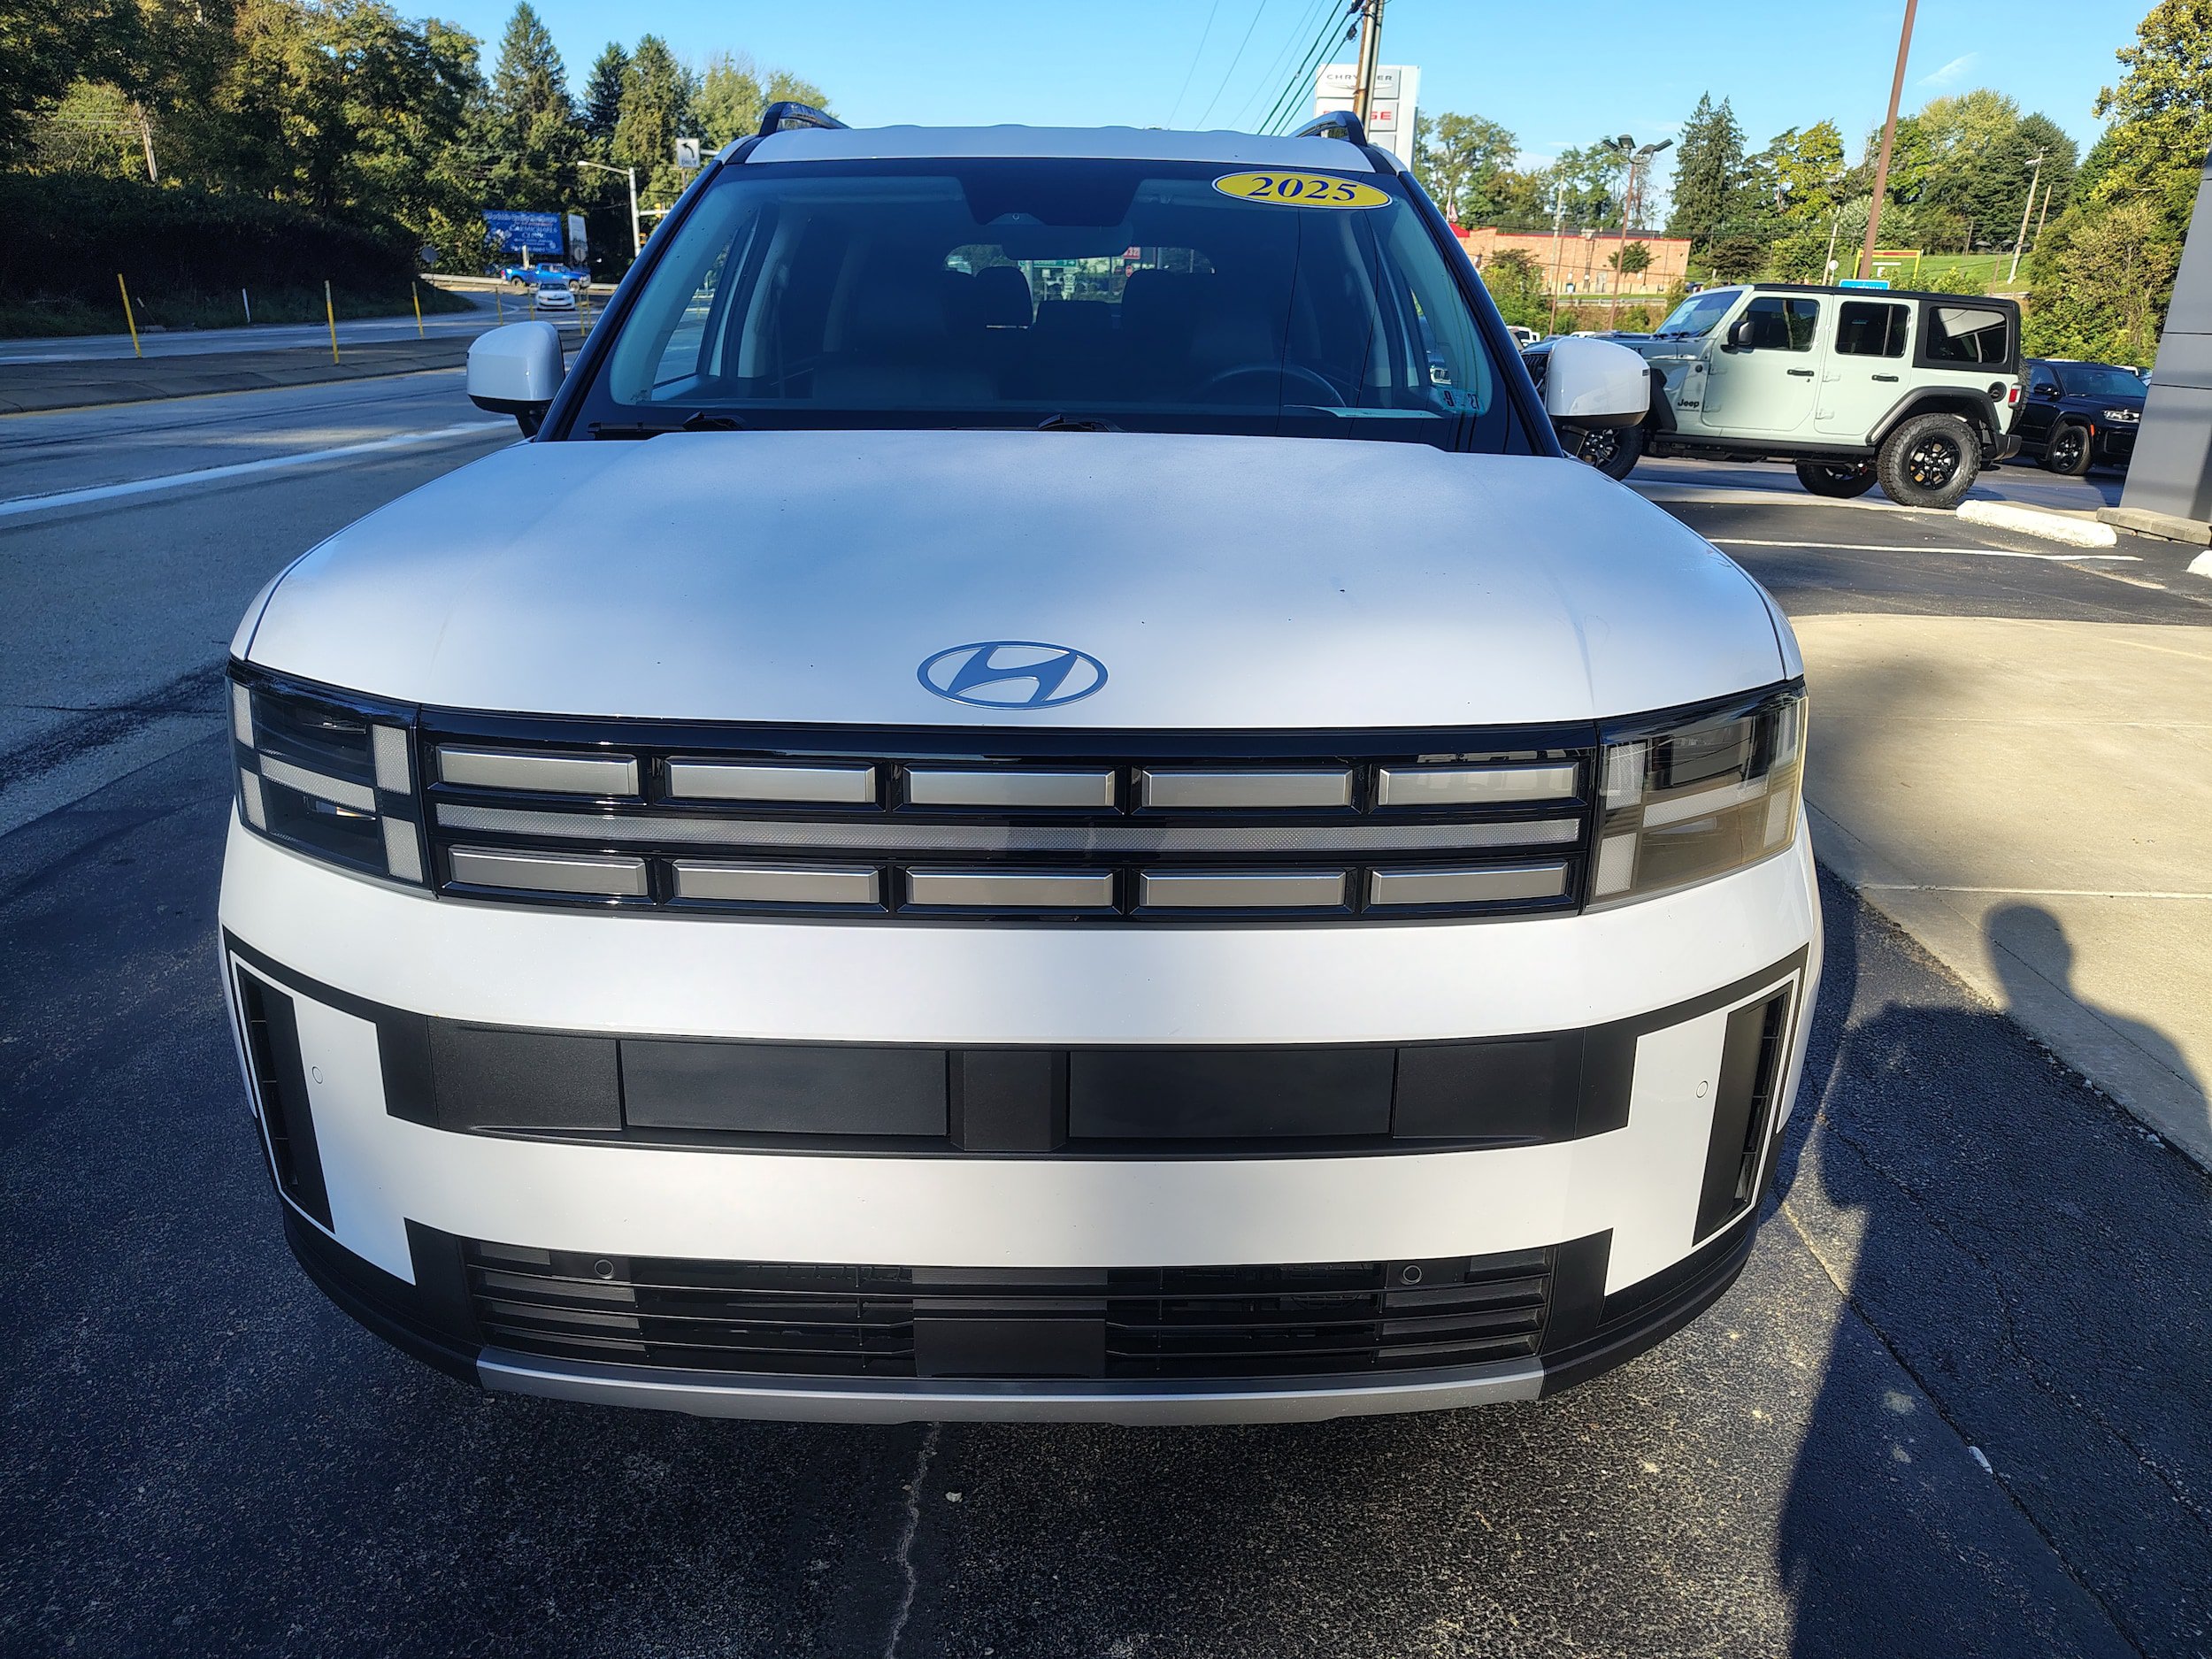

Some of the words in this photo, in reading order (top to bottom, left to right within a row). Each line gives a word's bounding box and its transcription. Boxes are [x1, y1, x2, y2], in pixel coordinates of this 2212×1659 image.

[1248, 177, 1358, 201] 2025
[1443, 390, 1455, 407] 9
[1467, 393, 1480, 411] 27
[1678, 399, 1700, 408] Jeep
